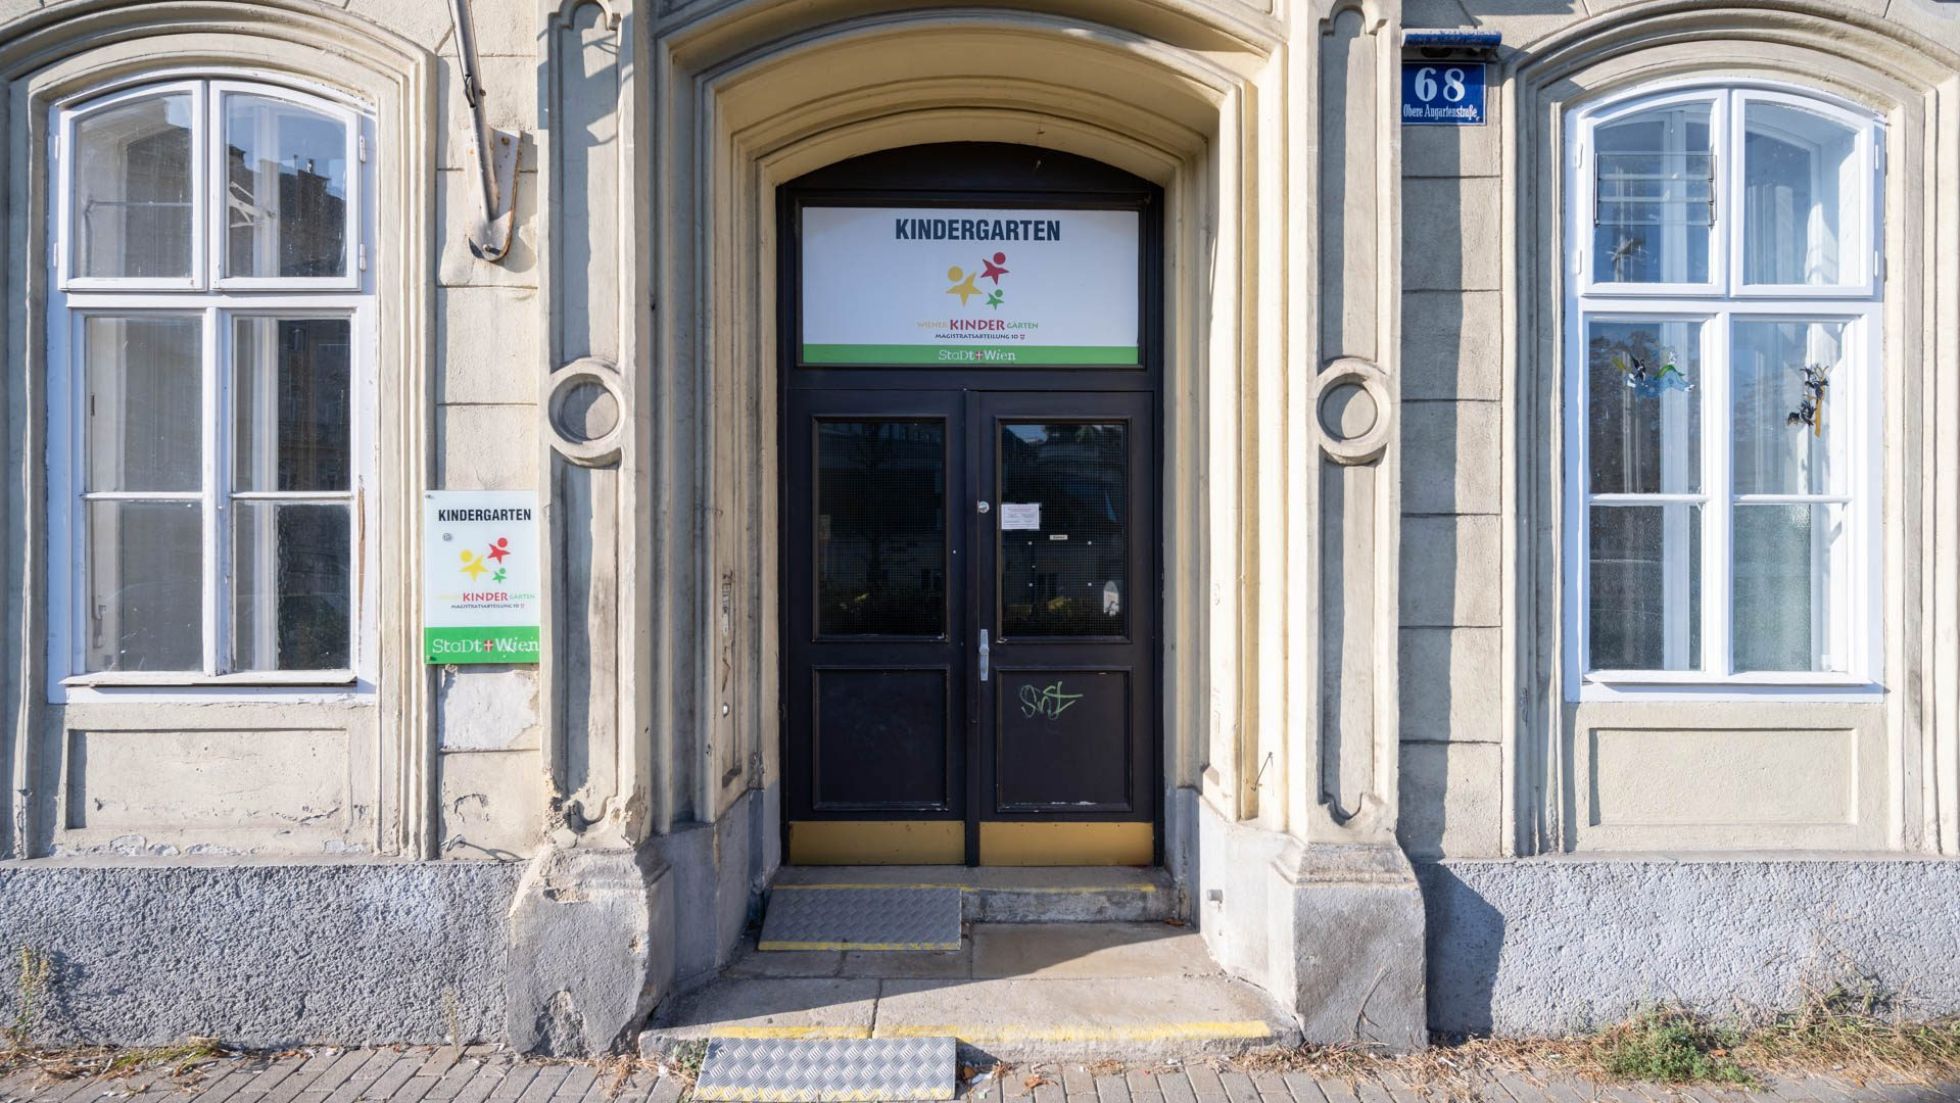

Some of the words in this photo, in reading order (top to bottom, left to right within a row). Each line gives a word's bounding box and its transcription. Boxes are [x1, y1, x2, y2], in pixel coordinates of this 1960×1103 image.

[1414, 67, 1466, 102] 68
[1403, 104, 1424, 118] Obere
[895, 218, 1061, 241] KINDERGARTEN
[949, 319, 1005, 331] KINDER
[983, 349, 1016, 361] Wien
[438, 509, 532, 522] KINDERGARTEN
[463, 592, 508, 602] KINDER
[495, 637, 539, 653] Wien
